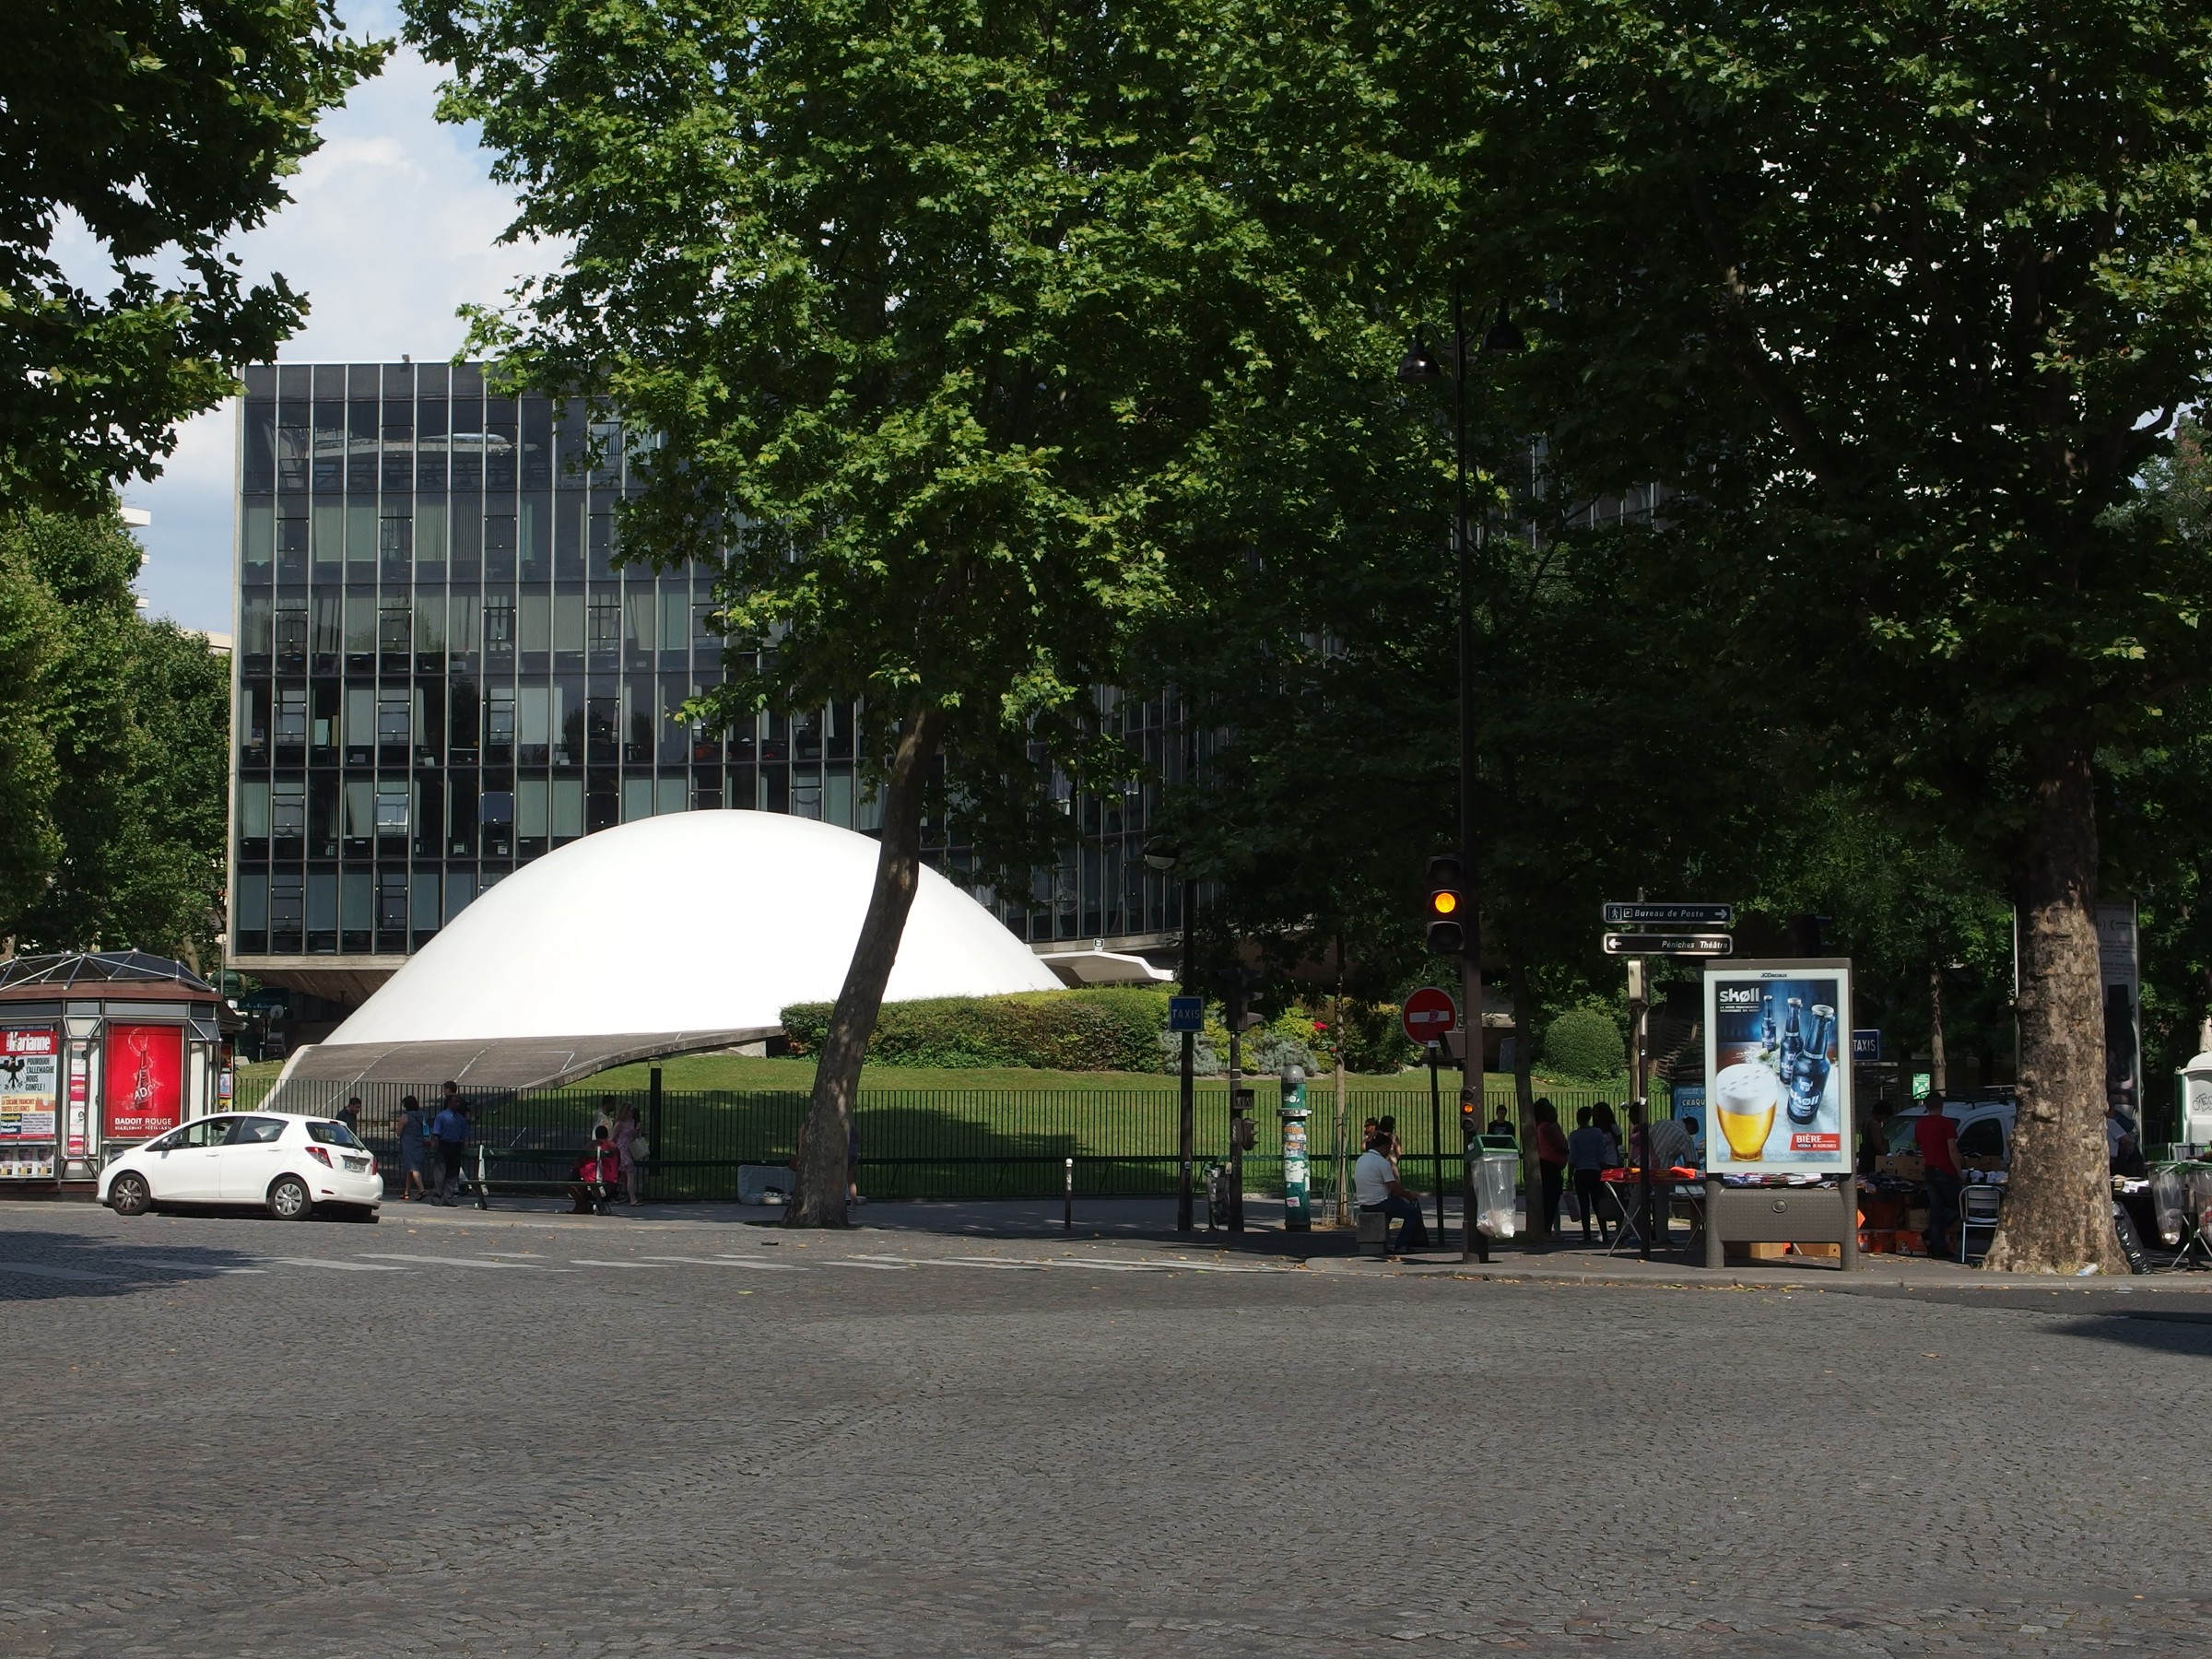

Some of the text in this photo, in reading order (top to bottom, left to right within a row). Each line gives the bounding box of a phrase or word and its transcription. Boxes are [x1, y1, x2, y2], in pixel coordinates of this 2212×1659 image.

[1661, 940, 1728, 948] Péniches Théâtre
[1171, 1009, 1200, 1018] TAXIS
[6, 1031, 51, 1052] Marianne
[1853, 1040, 1877, 1052] TAXIS
[1796, 1134, 1822, 1143] BIÈRE
